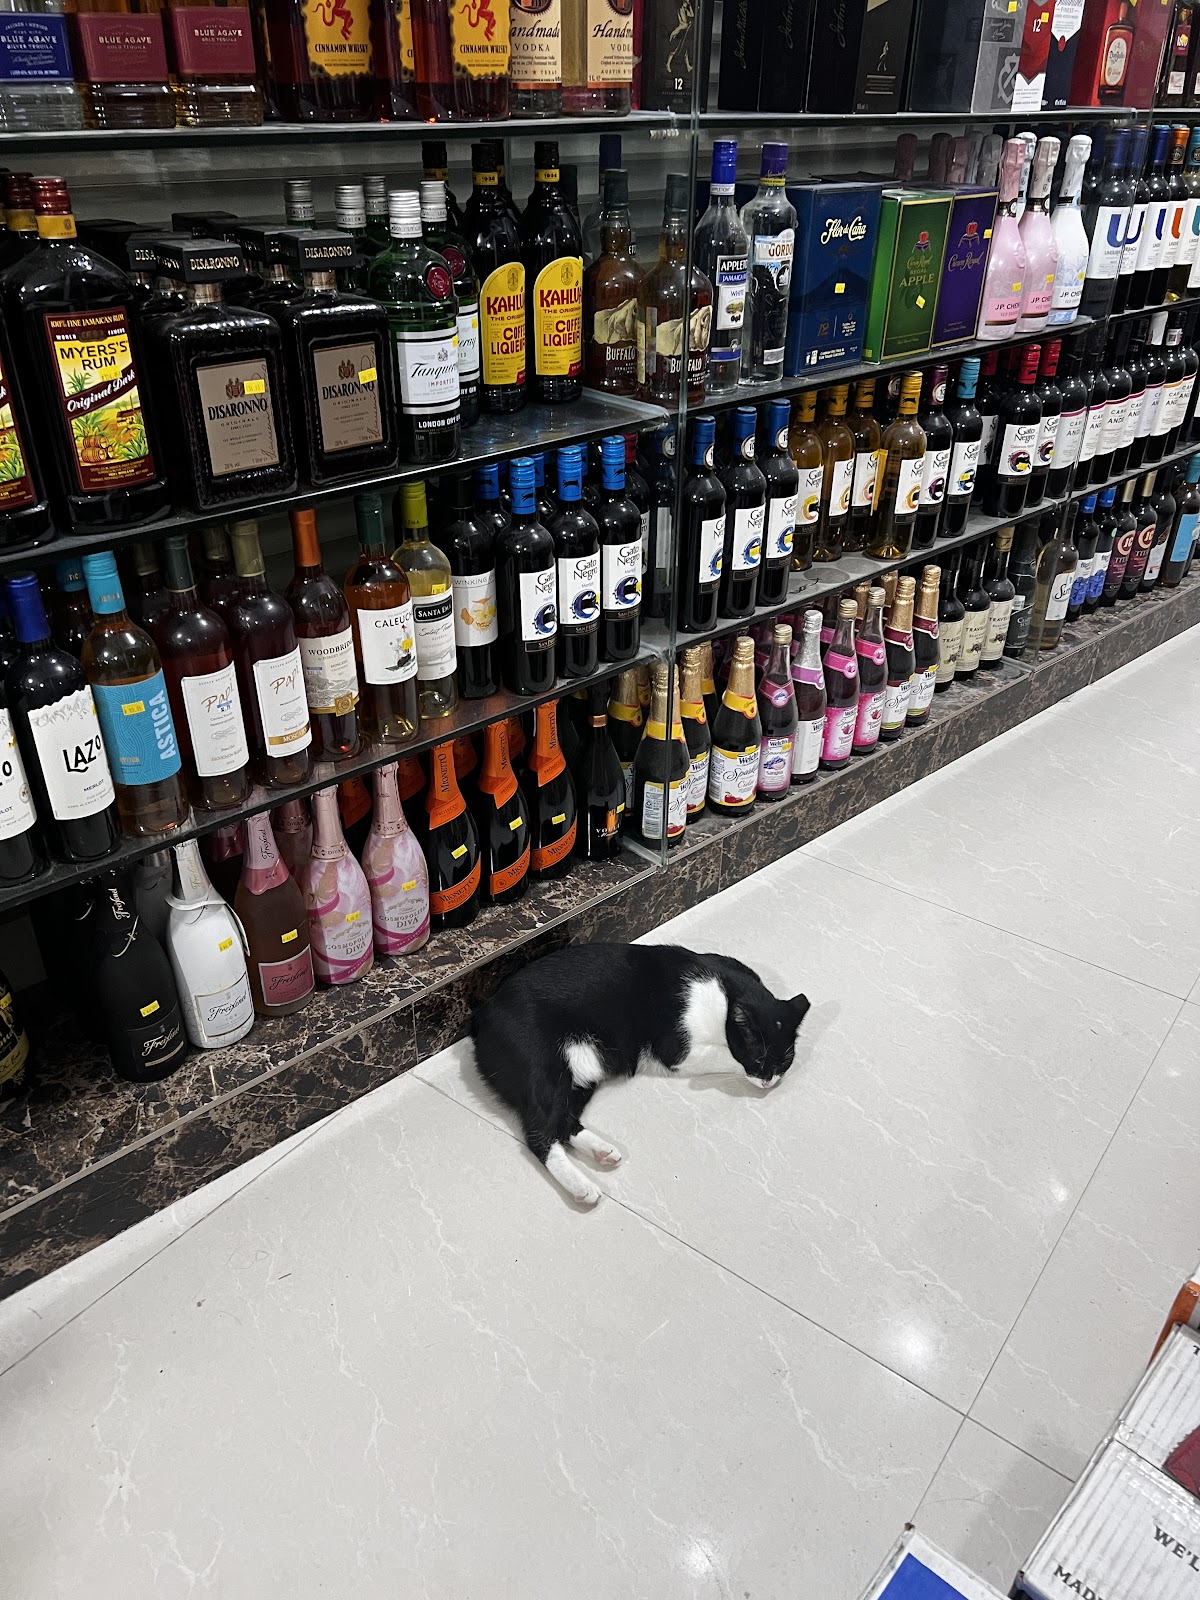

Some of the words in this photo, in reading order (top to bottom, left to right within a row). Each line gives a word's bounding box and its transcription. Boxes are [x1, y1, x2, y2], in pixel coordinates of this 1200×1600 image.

[194, 29, 215, 37] BLUE
[217, 29, 243, 37] AGAVE
[1032, 18, 1042, 33] 12
[0, 35, 25, 43] BLUE
[27, 35, 58, 44] AGAVE
[98, 36, 122, 44] BLUE
[124, 36, 152, 44] AGAVE
[315, 43, 347, 53] CINNAMON
[347, 43, 368, 53] WHISKY
[460, 44, 489, 53] CINNAMON
[514, 43, 551, 52] VODKA
[674, 78, 683, 90] 12
[821, 218, 844, 245] Flor
[848, 216, 866, 241] Caña
[304, 246, 353, 259] DISARONNO
[768, 243, 794, 257] GORDO
[190, 256, 240, 271] DISARONNO
[899, 273, 934, 288] APPLE
[67, 319, 82, 327] FINE
[82, 316, 112, 327] JAMAICAN
[60, 341, 128, 360] MYERS'S
[606, 346, 635, 361] BUFFALO
[82, 356, 116, 371] RUM
[670, 357, 702, 373] BUFALO
[66, 382, 112, 413] Original
[112, 369, 136, 393] Dark
[322, 381, 375, 400] DISARONNO
[207, 397, 268, 421] DISARONNO
[418, 418, 446, 429] LONDON
[1017, 426, 1035, 436] Gato
[1013, 434, 1036, 443] Negro
[617, 553, 640, 566] Negro
[619, 546, 639, 558] Gato
[573, 566, 598, 580] Negro
[575, 560, 597, 571] Gato
[453, 577, 488, 586] WINKING
[417, 608, 440, 618] SANTA
[307, 638, 353, 656] WOODBRID
[270, 660, 300, 695] Papi
[200, 677, 234, 713] Papi
[148, 689, 176, 762] ASTICA
[548, 711, 557, 749] MIONETTO
[62, 734, 101, 774] LAZO
[499, 731, 508, 770] MIONETTO
[438, 753, 450, 793] MIONETTO
[84, 778, 104, 791] MERLOT
[0, 805, 14, 814] LOT
[440, 876, 476, 903] MIONETTO
[379, 902, 429, 922] COSMOPOLITA
[396, 917, 419, 929] DIVA
[345, 942, 366, 956] DIVA
[269, 963, 309, 990] Freixenet
[207, 990, 247, 1022] Freixenet
[141, 1020, 180, 1057] Freixenet
[1153, 1525, 1200, 1573] WE'L
